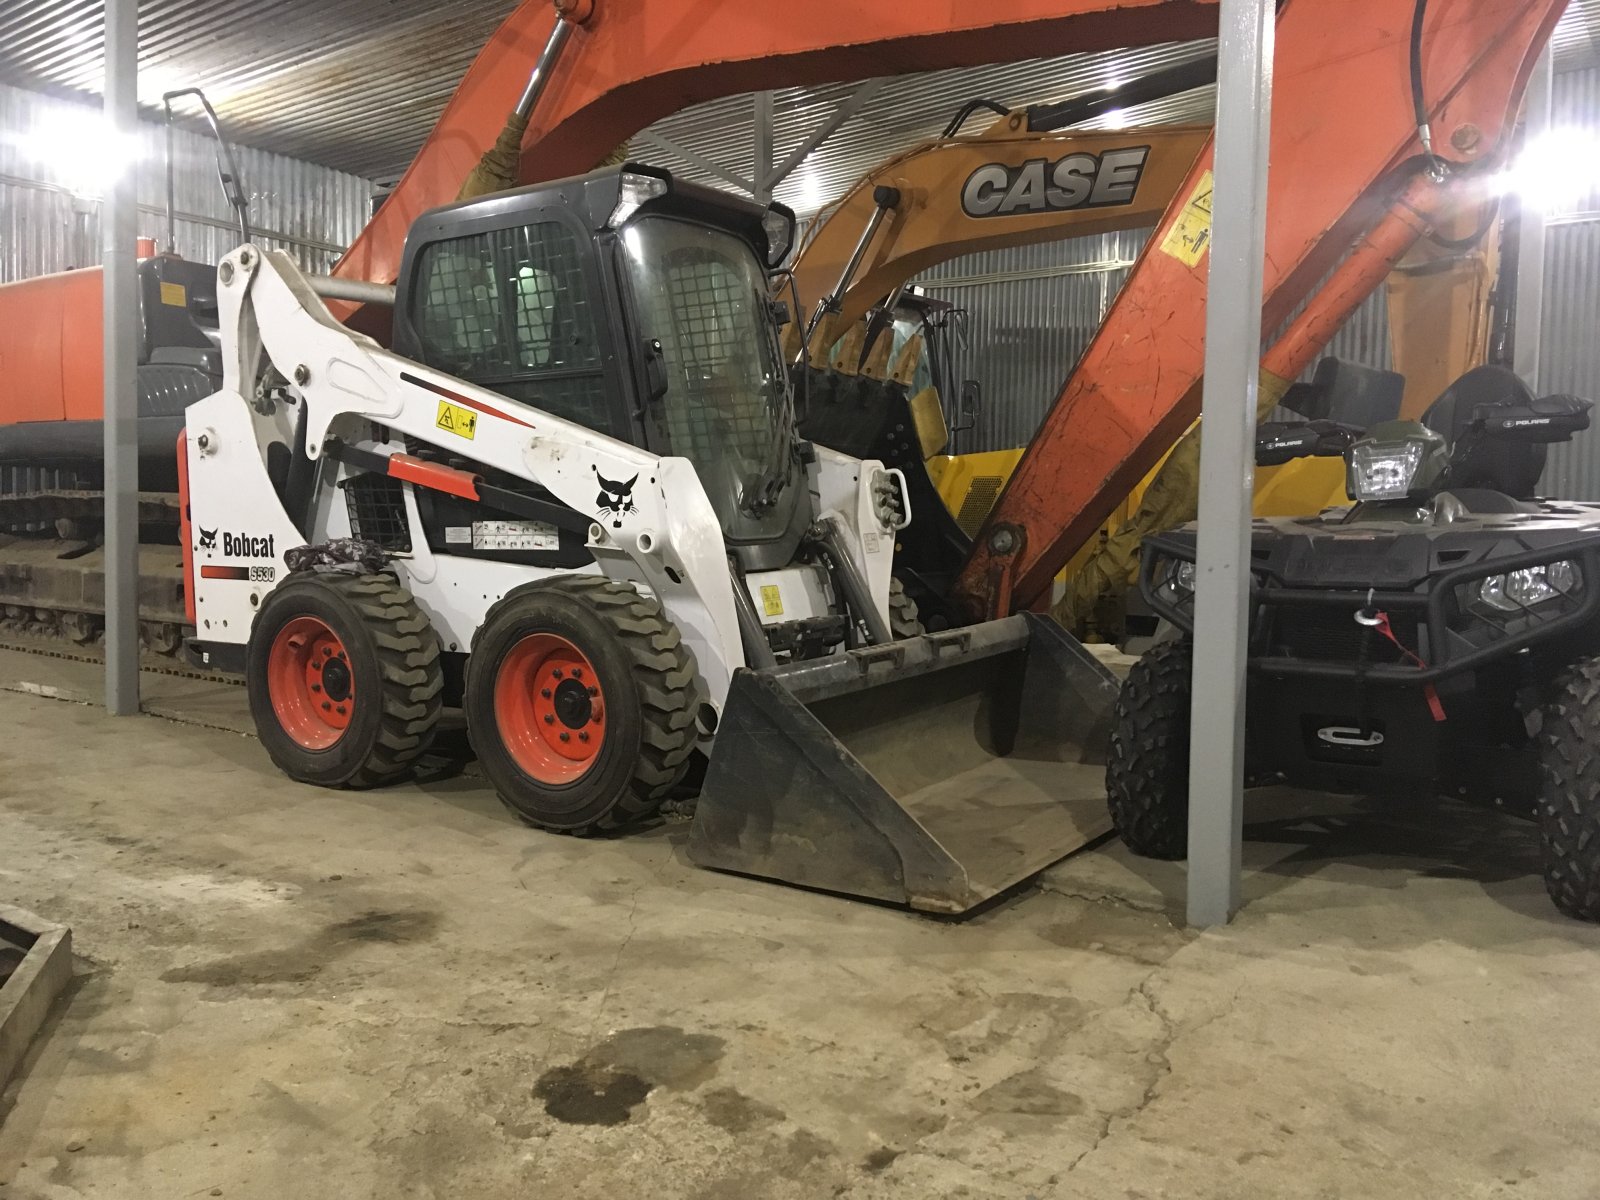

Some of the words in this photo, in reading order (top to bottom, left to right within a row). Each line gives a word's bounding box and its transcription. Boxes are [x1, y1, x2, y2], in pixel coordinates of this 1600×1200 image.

[962, 147, 1149, 216] CASE
[223, 532, 275, 558] Bobcat
[250, 566, 275, 582] S530
